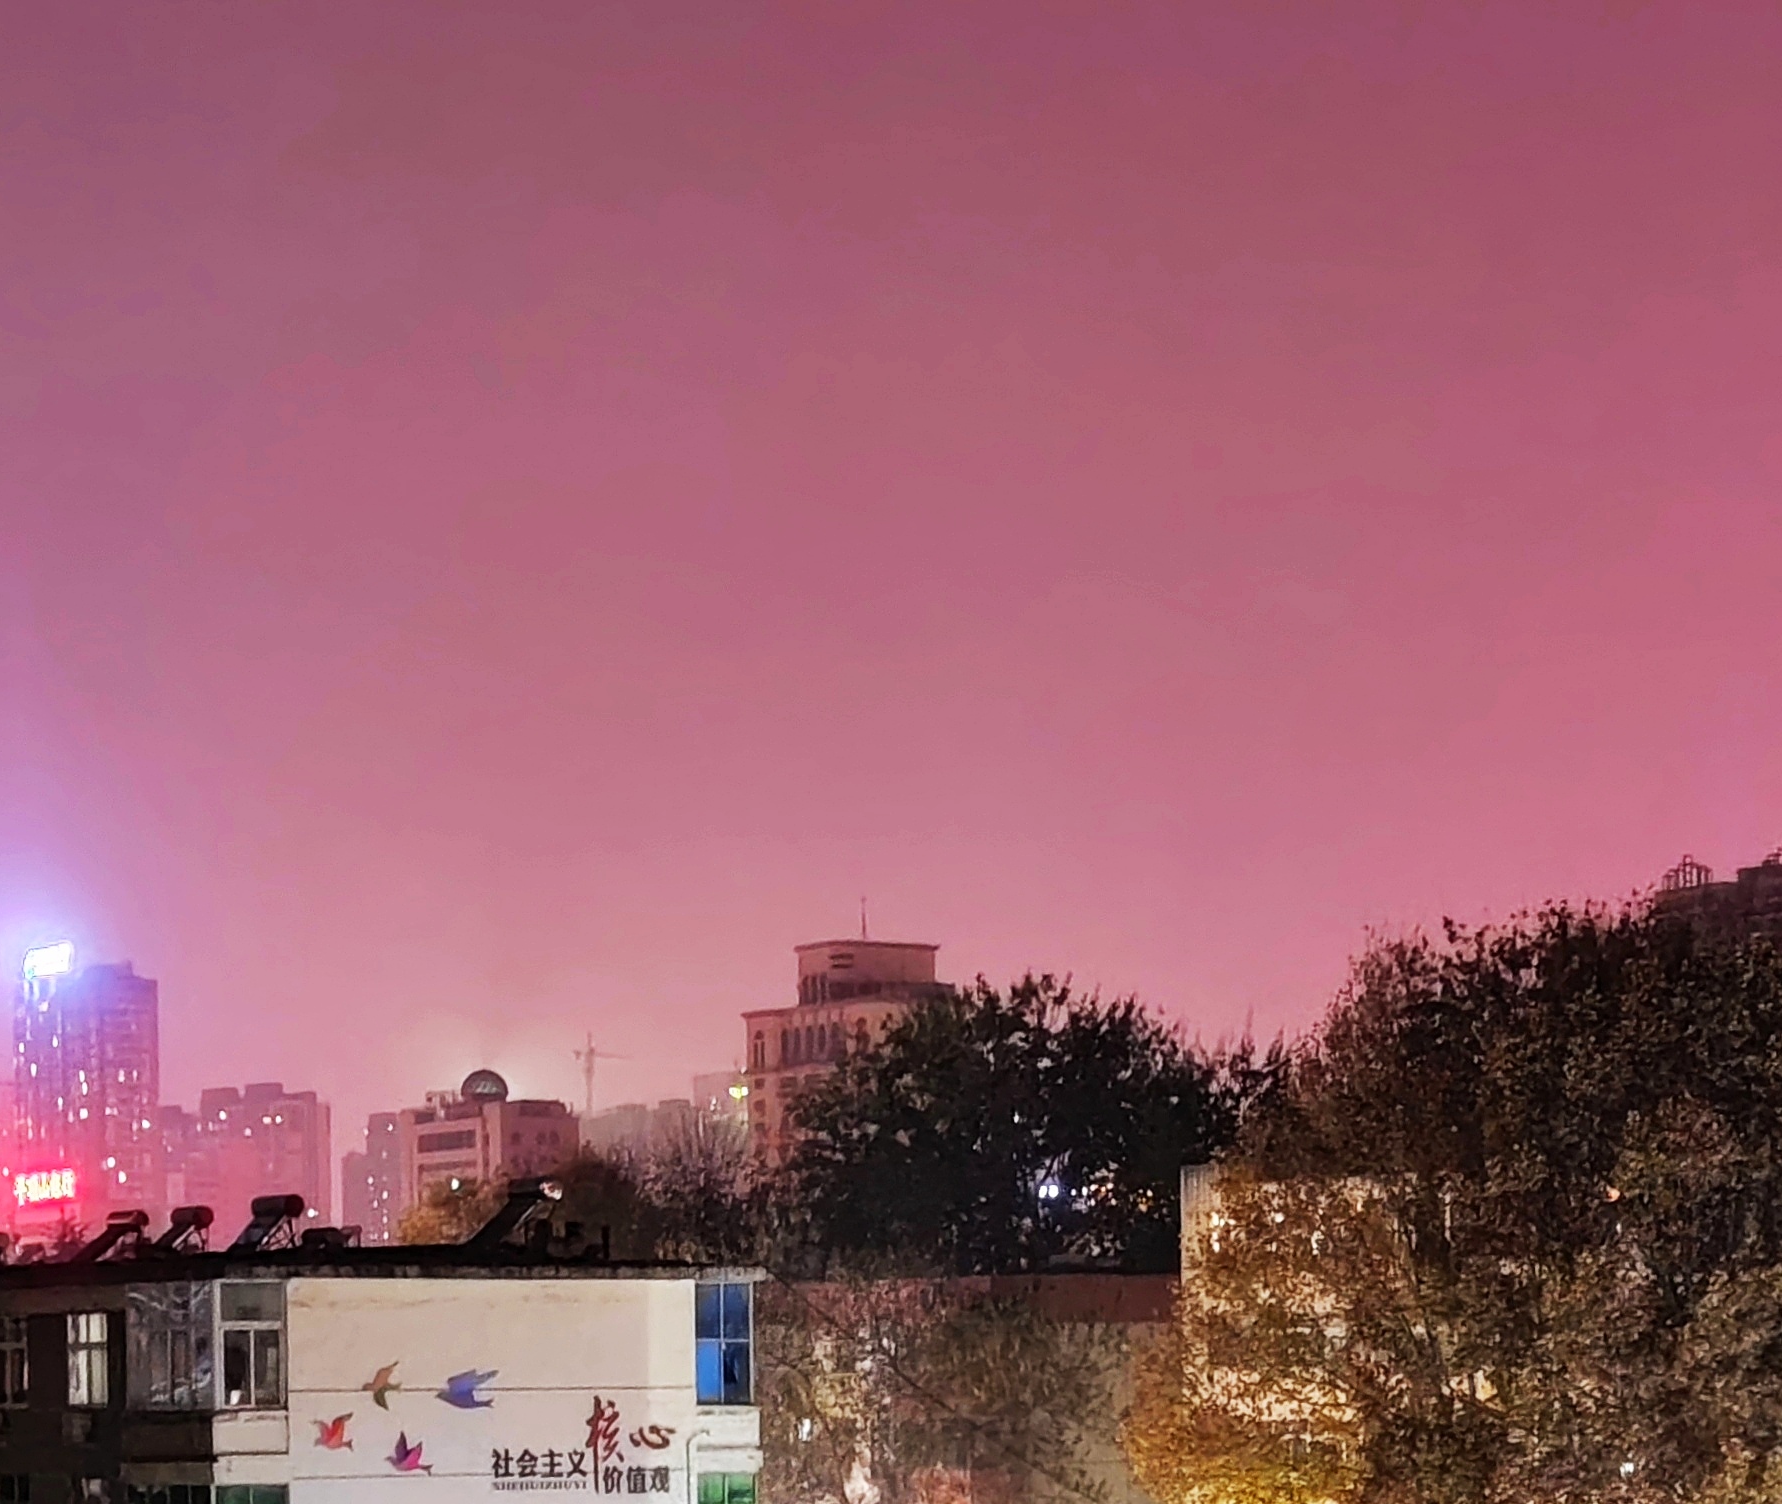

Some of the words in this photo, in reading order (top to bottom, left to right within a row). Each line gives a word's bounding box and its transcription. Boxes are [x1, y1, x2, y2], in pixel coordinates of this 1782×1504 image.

[585, 1395, 676, 1494] 核心
[491, 1449, 587, 1478] 社会主义
[602, 1465, 670, 1494] 价值观
